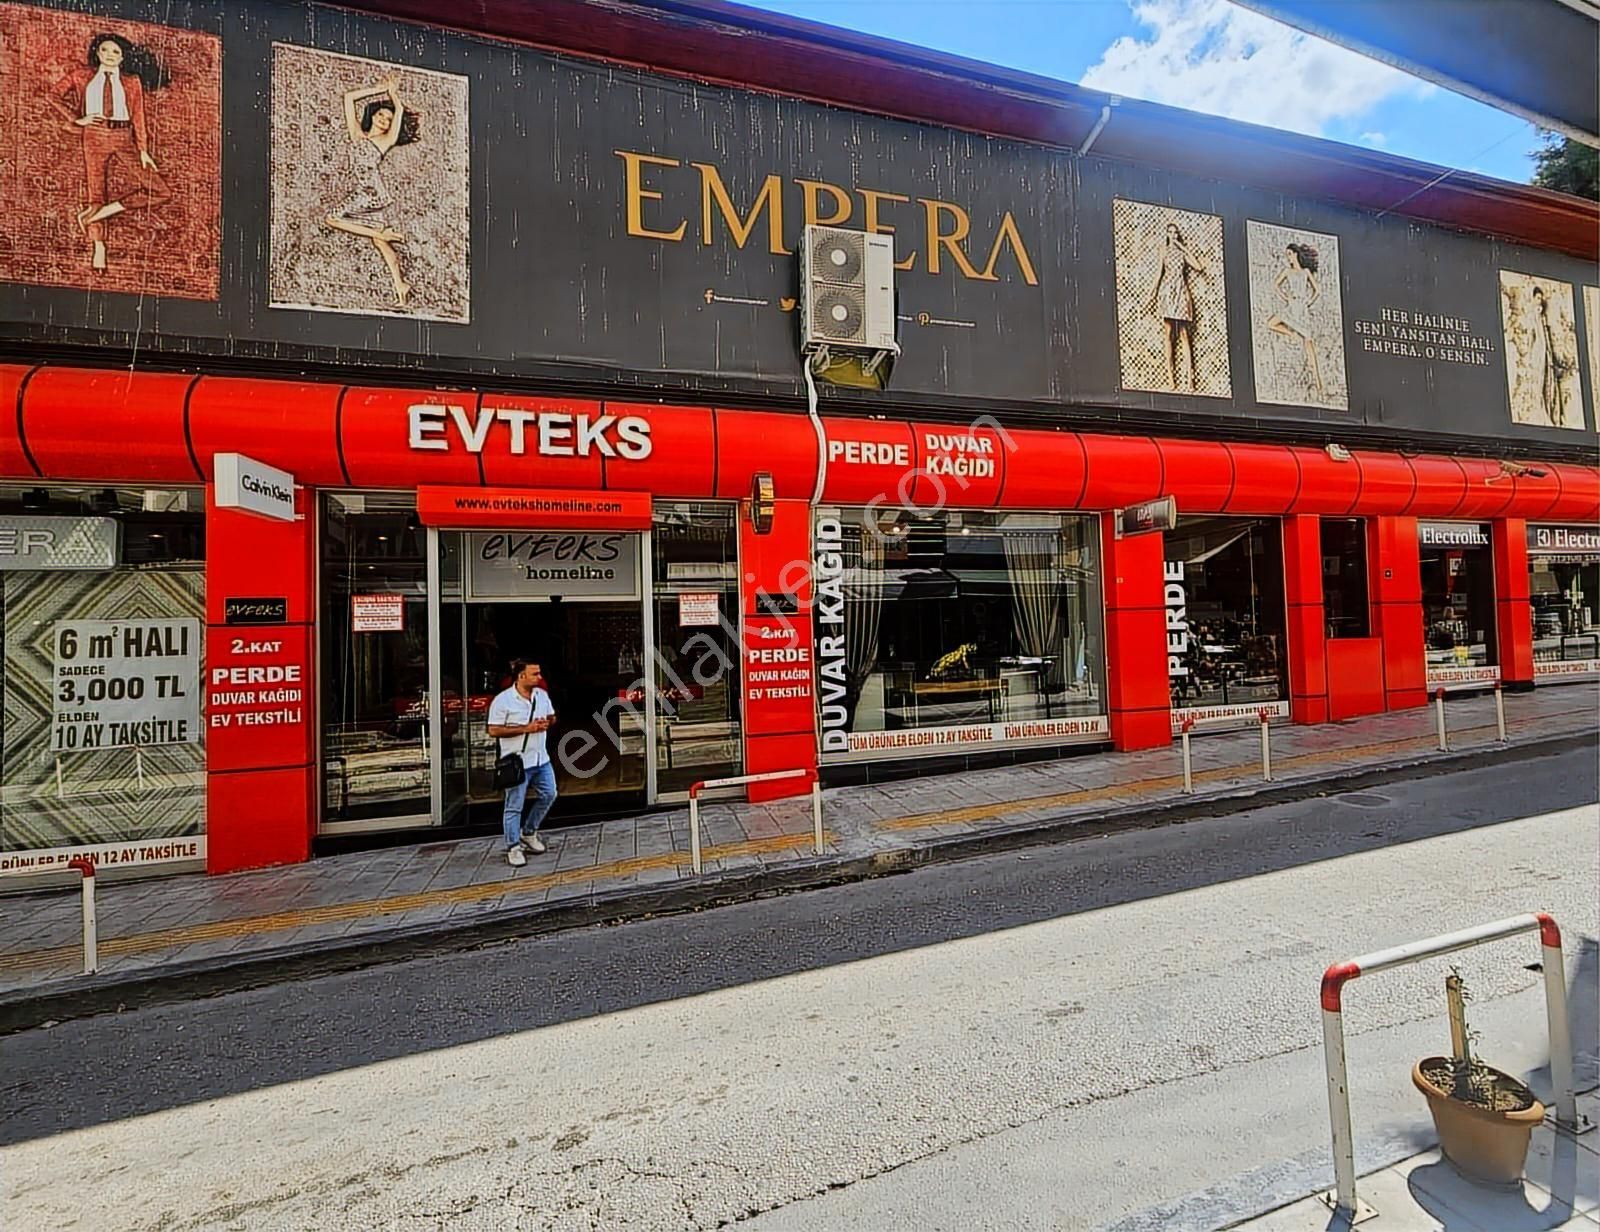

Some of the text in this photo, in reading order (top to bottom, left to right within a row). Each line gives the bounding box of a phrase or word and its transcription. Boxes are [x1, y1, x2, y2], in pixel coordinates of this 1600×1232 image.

[1382, 308, 1409, 323] HER
[1392, 326, 1456, 345] YANSITAN
[1364, 339, 1422, 357] EMPERA.
[1425, 346, 1435, 358] O
[407, 404, 652, 459] EVTEKS
[829, 440, 909, 466] PERDE
[925, 434, 994, 453] DUVAR
[926, 453, 995, 477] KAĞIDI
[242, 475, 292, 504] Calvin Klein
[455, 498, 622, 513] www.evtekshomeline.com
[1422, 527, 1489, 545] Electrolux
[526, 566, 614, 580] homeline
[1163, 561, 1189, 675] PERDE
[761, 627, 796, 639] 2.KAT
[59, 628, 78, 659] 6
[124, 627, 188, 657] HALI
[231, 639, 282, 653] 2.KAT
[749, 649, 810, 663] PERDE
[59, 666, 105, 676] SADECE
[212, 666, 301, 684] PERDE
[749, 671, 778, 682] DUVAR
[59, 676, 185, 706] 3,000 TL
[212, 688, 301, 705] DUVAR KAĞIDI
[749, 689, 763, 700] EV
[820, 634, 848, 752] DUVAR
[58, 712, 99, 722] ELDEN
[211, 707, 301, 727] EV TEKSTİLİ
[56, 716, 187, 748] 10 AY TAKSİTLE
[1005, 726, 1021, 739] TÜM
[1057, 721, 1080, 734] ELDEN
[848, 735, 867, 750] TÜM
[908, 732, 934, 746] ELDEN
[936, 732, 945, 744] 12
[946, 731, 956, 743] AY
[104, 851, 117, 864] 12
[121, 849, 137, 862] AY
[139, 842, 197, 860] TAKSİTLE
